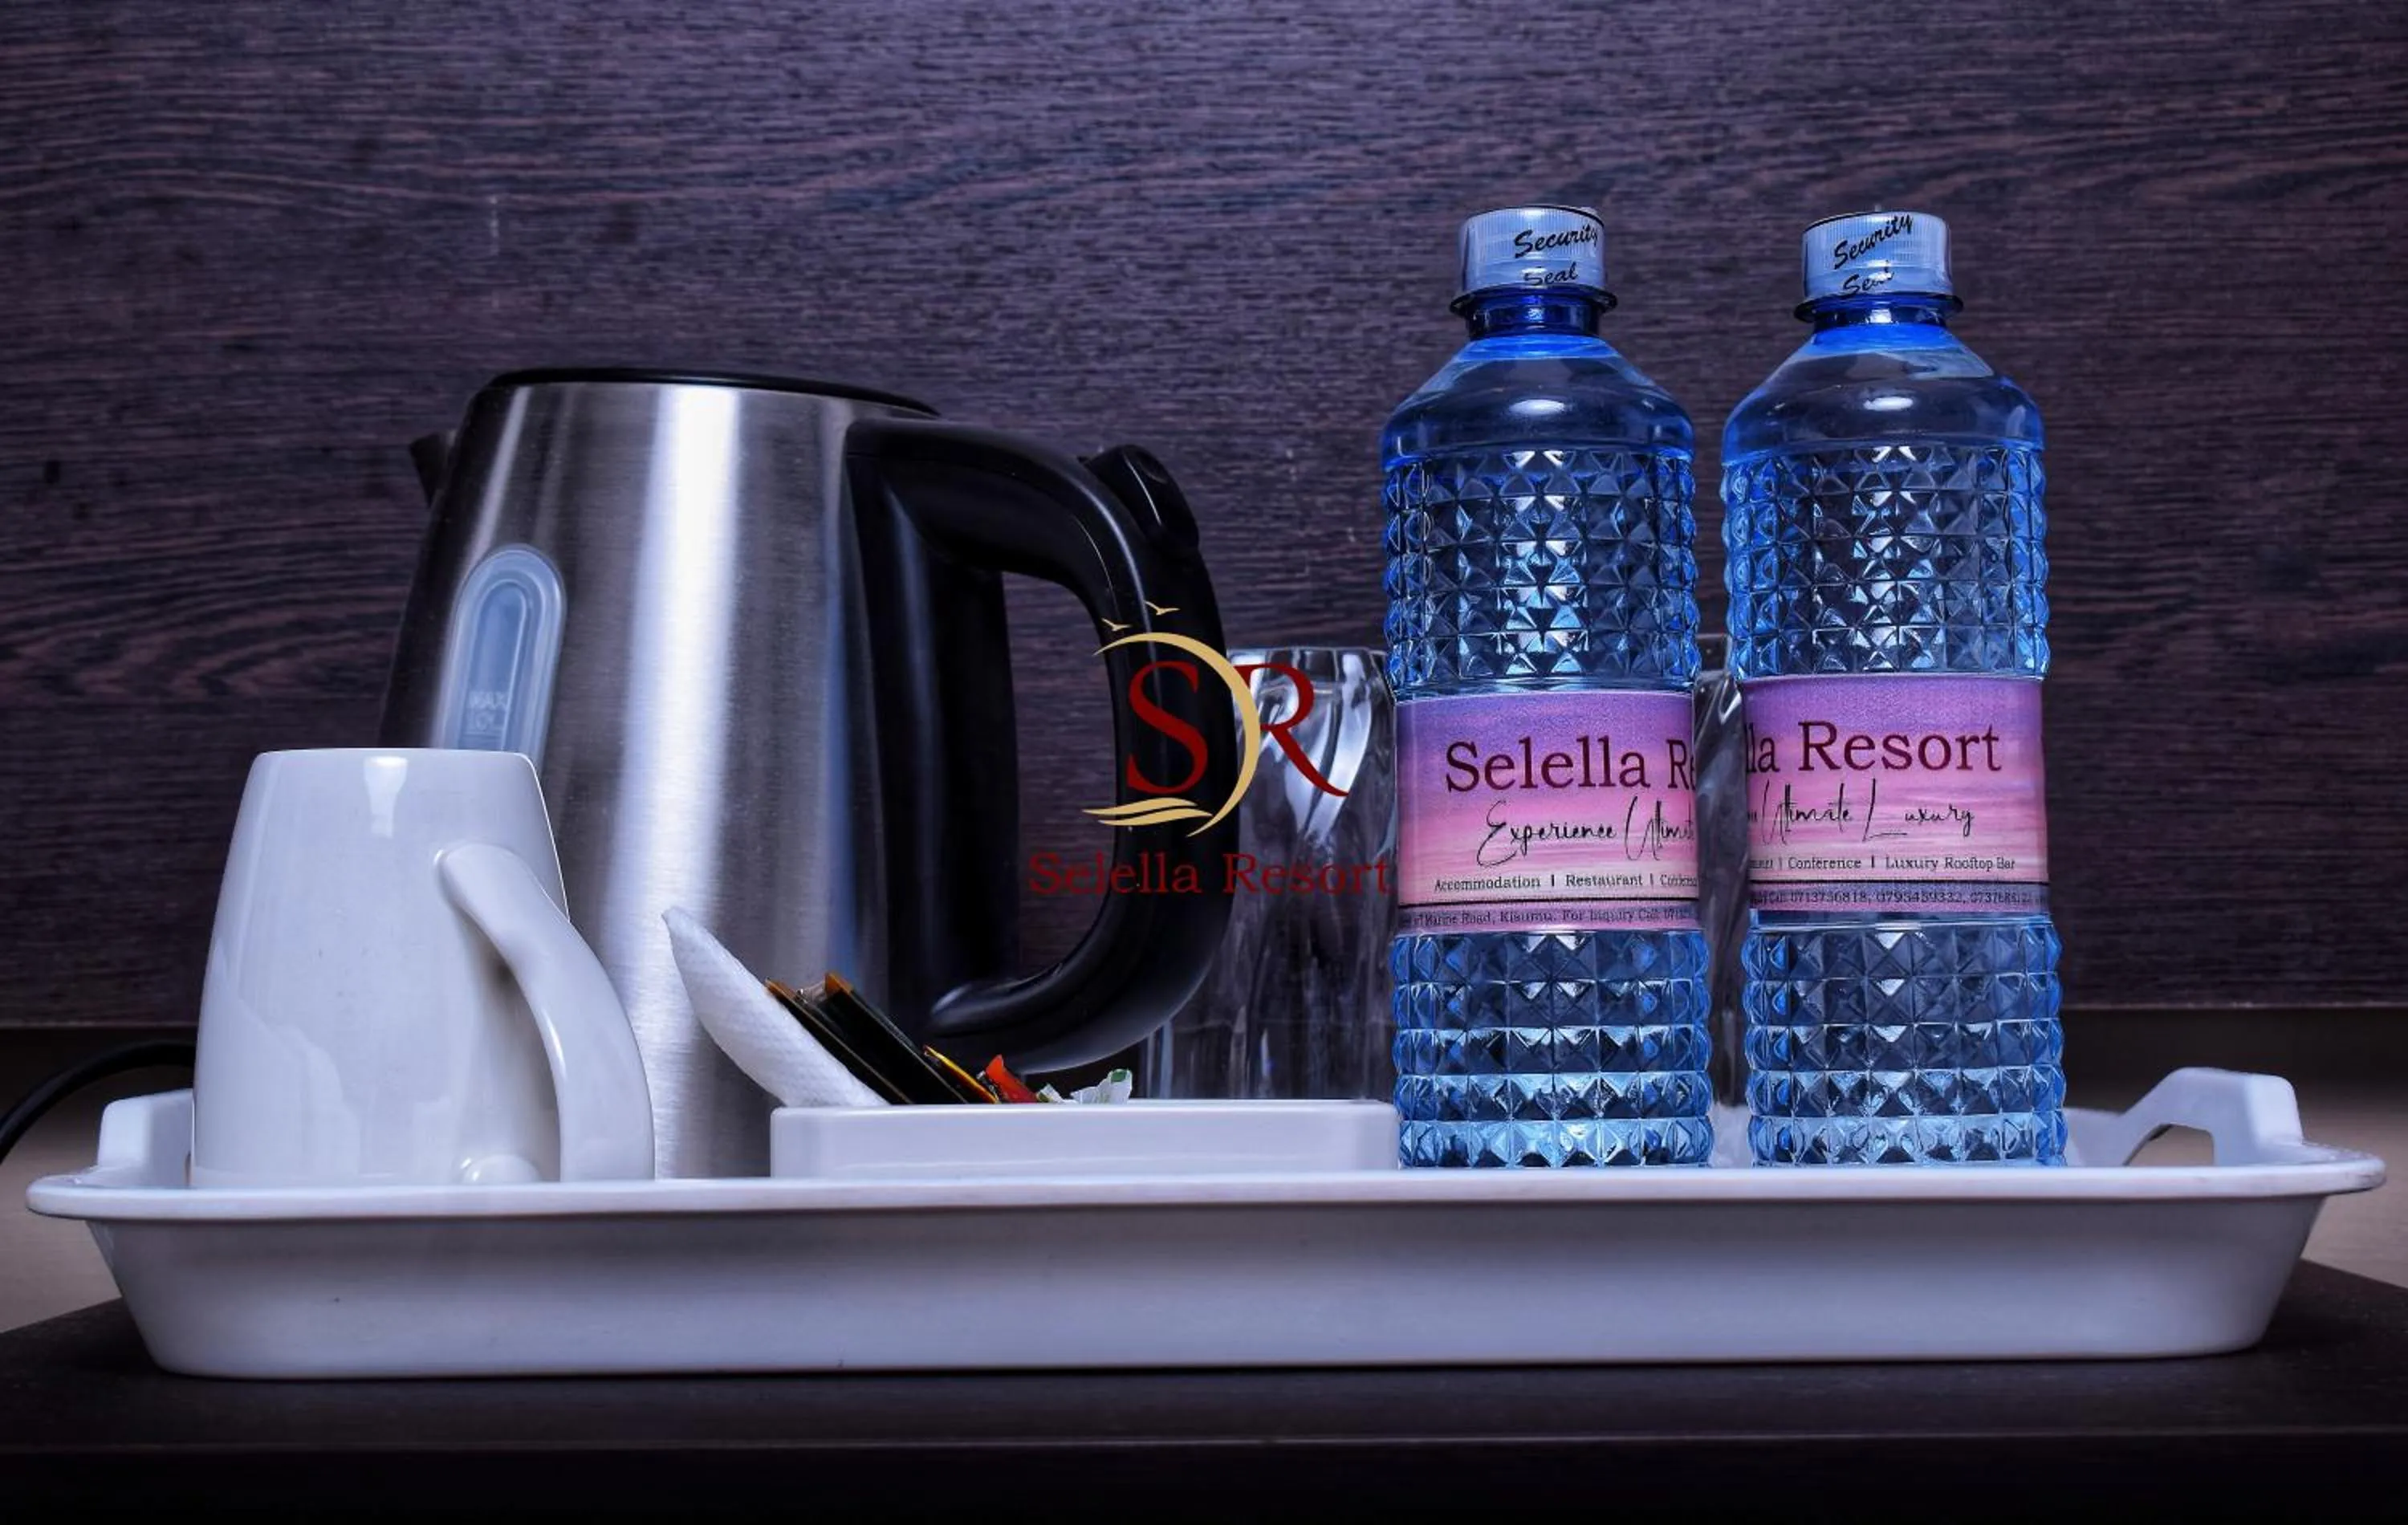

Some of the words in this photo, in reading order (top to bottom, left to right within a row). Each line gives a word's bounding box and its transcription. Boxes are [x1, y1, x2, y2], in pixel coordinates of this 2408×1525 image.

[1514, 224, 1598, 259] Security
[1834, 214, 1914, 270] Security
[1523, 262, 1578, 287] Seal
[1446, 735, 1650, 793] Selella
[1798, 720, 2002, 772] Resort
[1476, 799, 1616, 868] Experience
[1862, 778, 1973, 842] Luxury
[1434, 875, 1541, 893] Accommodation
[1566, 873, 1643, 887] Restaurant
[1788, 856, 1861, 869] Conference
[1885, 855, 1938, 872] Luxury
[1945, 856, 1993, 872] Rooftop
[1996, 856, 2015, 869] Bar
